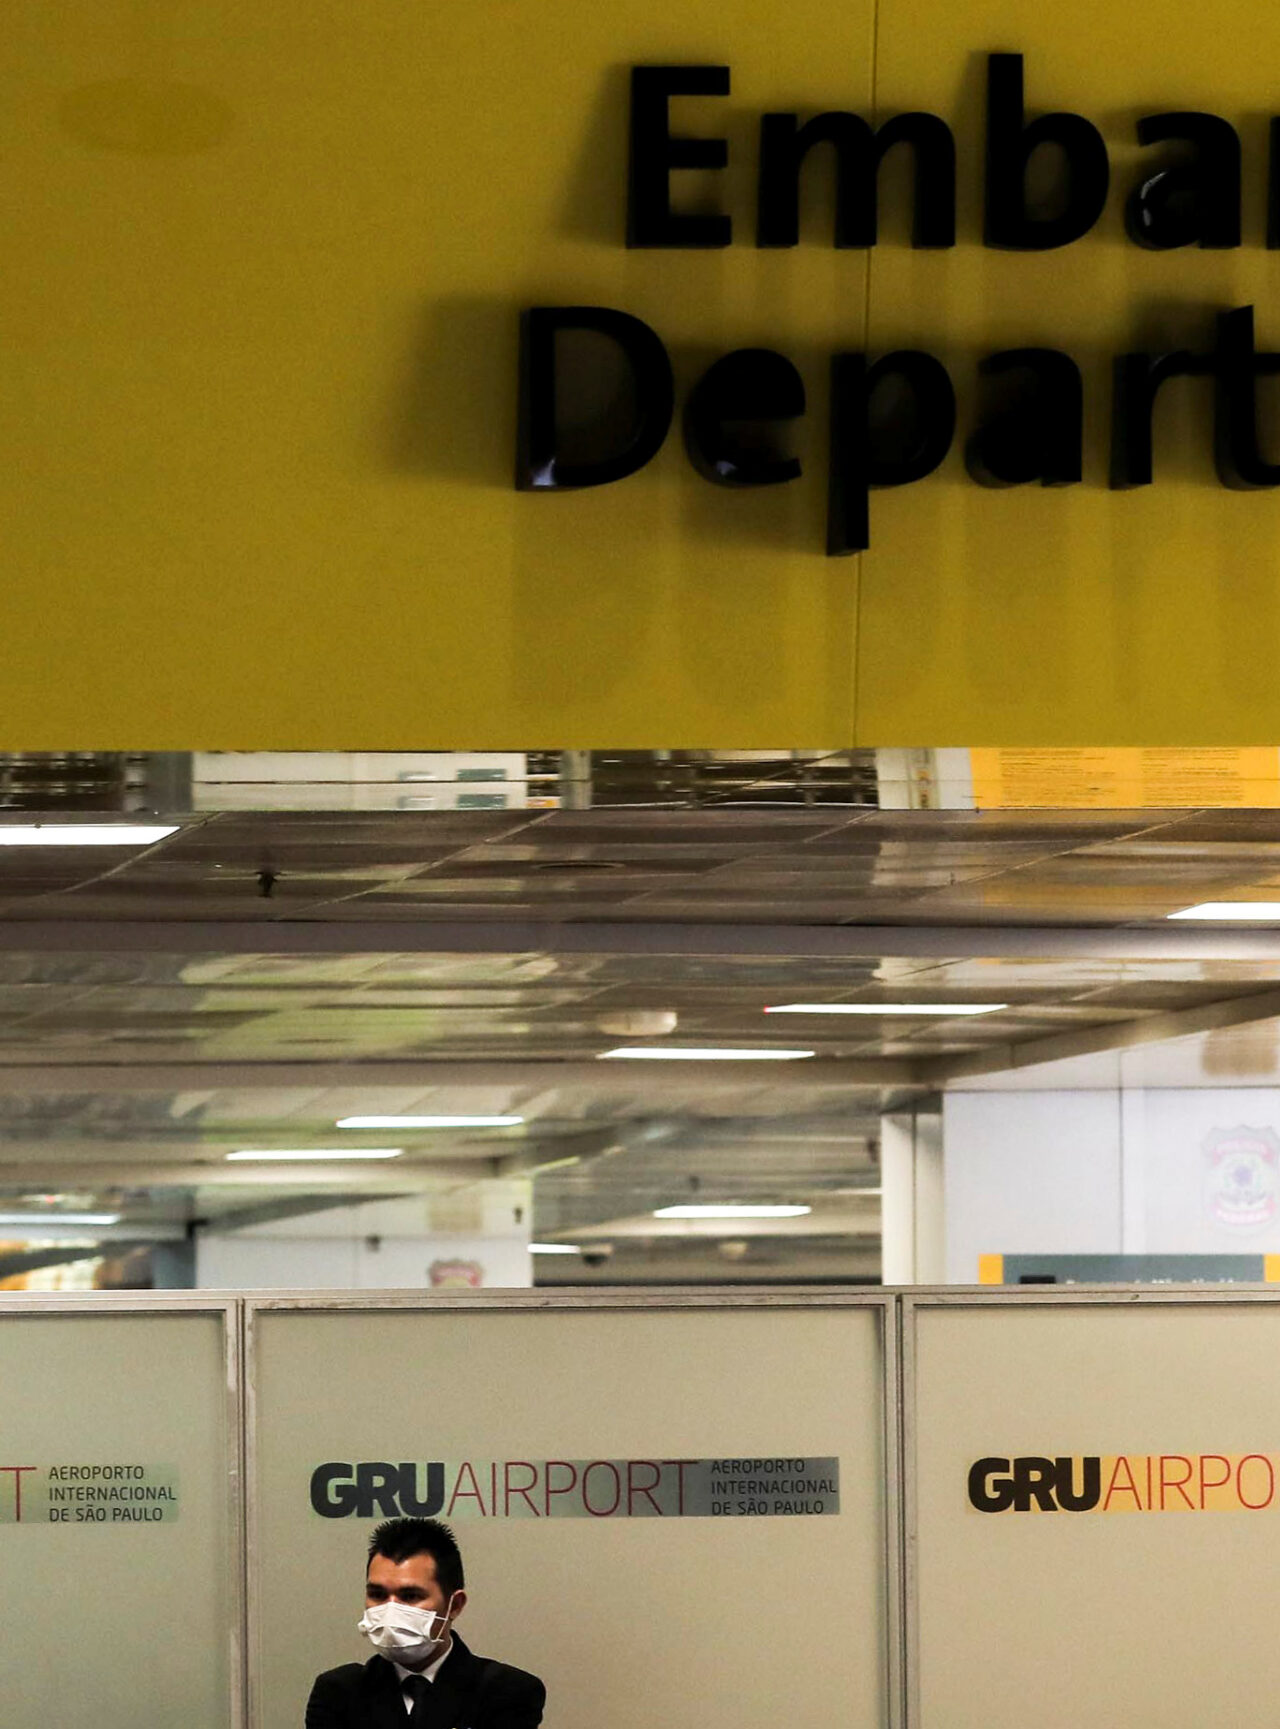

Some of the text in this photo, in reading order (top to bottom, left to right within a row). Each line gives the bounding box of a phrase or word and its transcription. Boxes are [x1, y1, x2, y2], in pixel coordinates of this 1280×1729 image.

[49, 1466, 144, 1480] AEROPORTO
[711, 1459, 805, 1474] AEROPORTO
[49, 1487, 177, 1501] INTERNACIONAL
[711, 1479, 837, 1495] INTERNACIONAL
[50, 1504, 163, 1522] DE SÃO PAULO
[712, 1498, 824, 1515] DE SÃO PAULO
